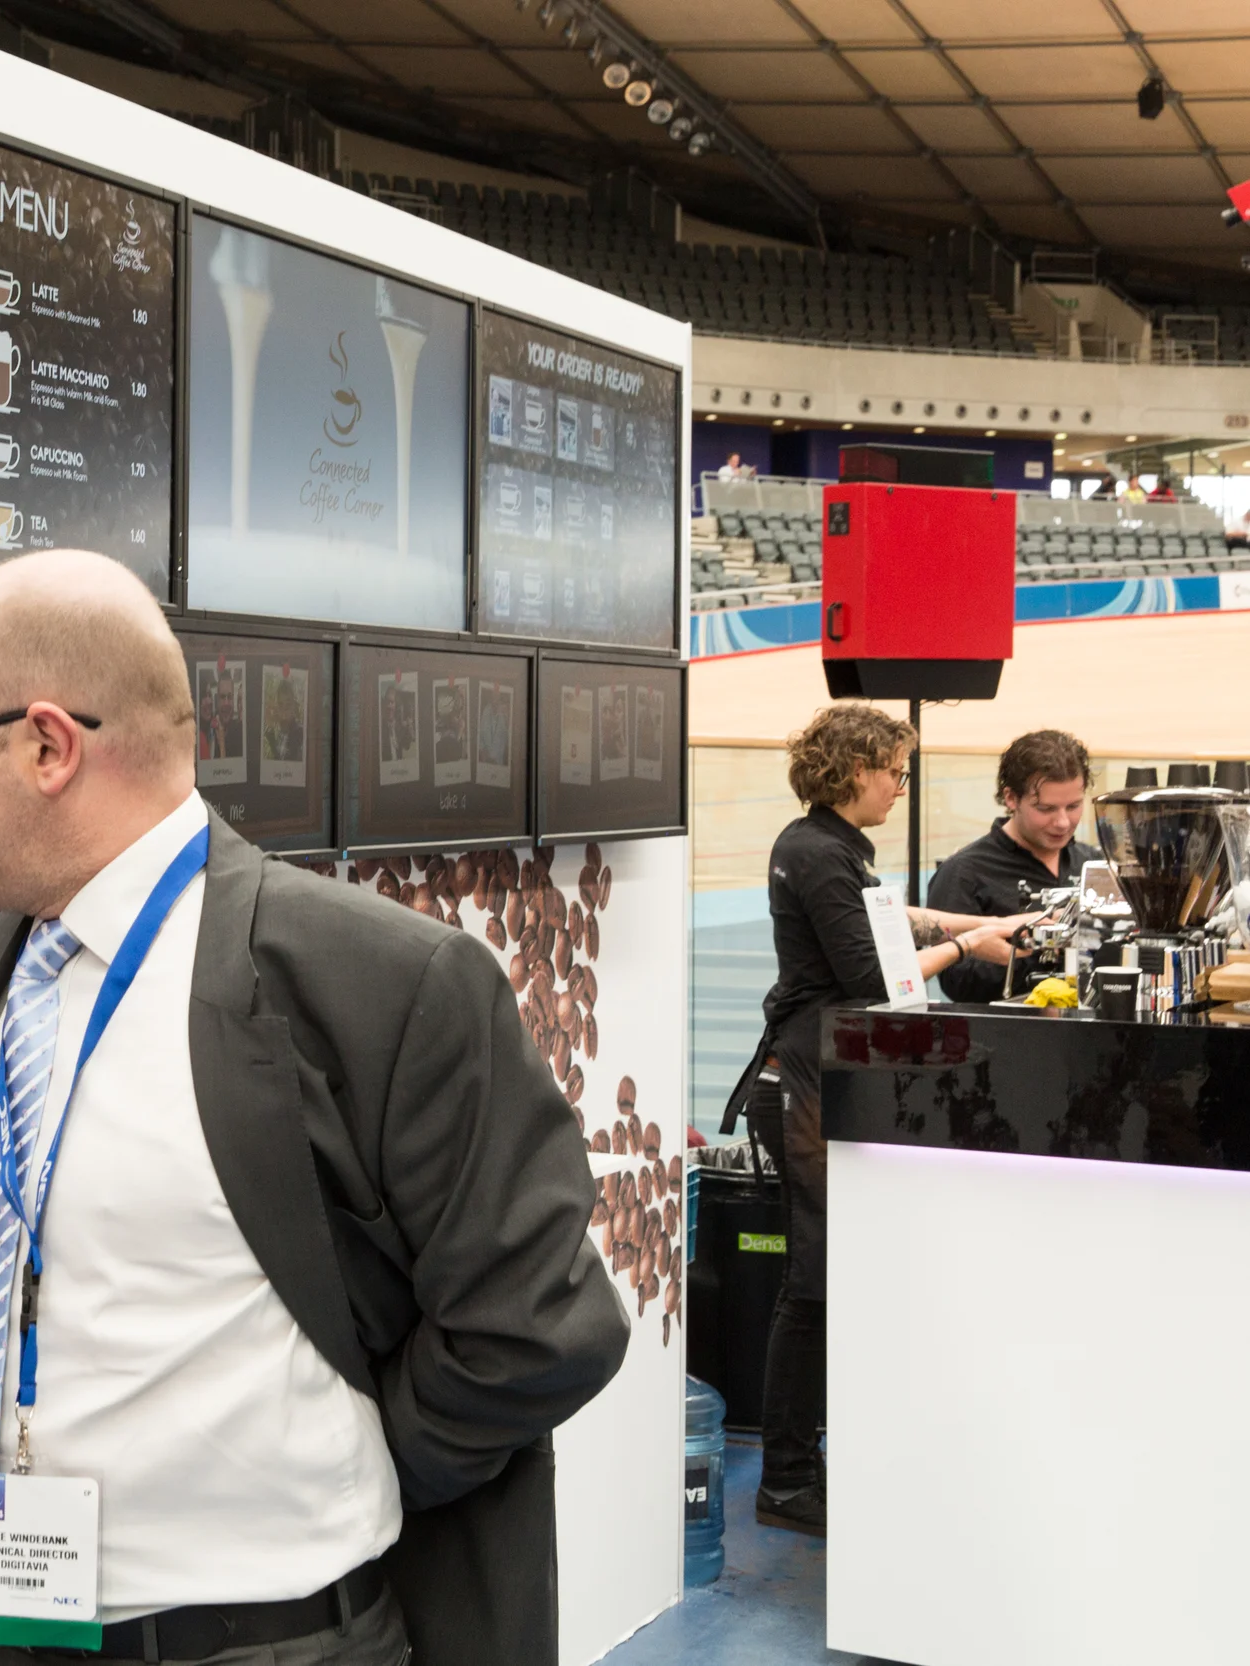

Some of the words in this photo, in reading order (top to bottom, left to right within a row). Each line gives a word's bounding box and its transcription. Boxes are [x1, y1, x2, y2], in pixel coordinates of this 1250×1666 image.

[32, 281, 59, 303] LATTE
[31, 301, 55, 317] Espresso
[132, 308, 148, 325] 1.80
[527, 341, 556, 371] YOUR
[557, 350, 592, 382] ORDER
[593, 363, 604, 386] IS
[31, 359, 58, 379] LATTE
[59, 366, 110, 390] MACCHIATO
[31, 380, 54, 395] Espresso
[131, 381, 147, 398] 1.80
[51, 397, 65, 410] Glass
[30, 444, 84, 468] CAPUCCINO
[30, 463, 53, 478] Espresso
[130, 462, 146, 478] 1.70
[309, 447, 372, 488] Connected
[299, 479, 340, 524] Coffee
[344, 486, 384, 521] Corner
[30, 515, 48, 531] TEA
[130, 528, 146, 544] 1.60
[230, 803, 245, 821] me
[9, 1533, 69, 1546] WINDEBANK
[29, 1548, 78, 1560] DIRECTOR
[0, 1559, 49, 1572] DIGITAVIA
[53, 1596, 84, 1607] NEC
